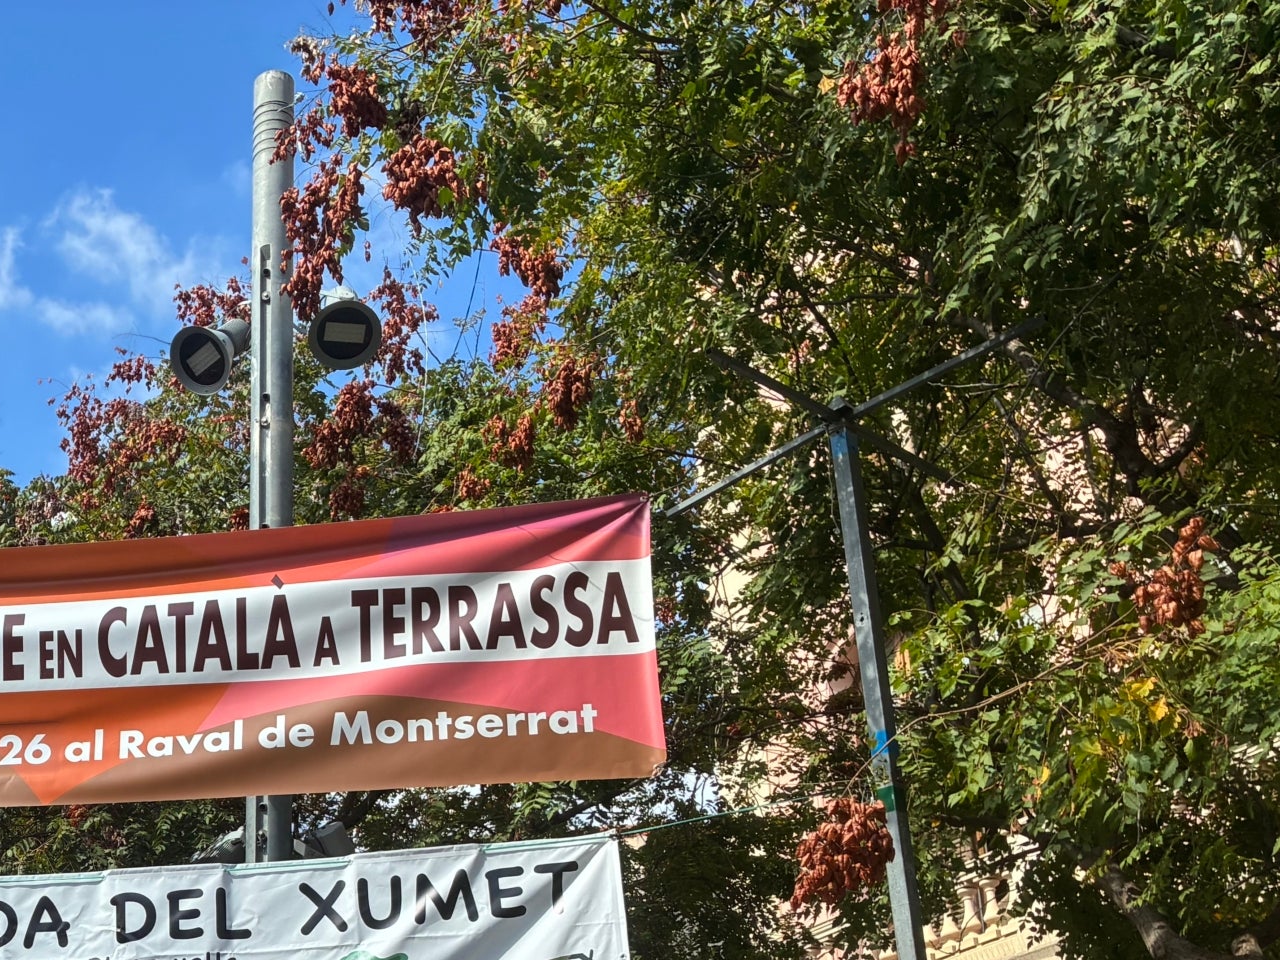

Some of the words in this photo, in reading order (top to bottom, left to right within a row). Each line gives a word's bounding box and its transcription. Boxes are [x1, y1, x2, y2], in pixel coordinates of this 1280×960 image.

[39, 629, 83, 679] EN
[98, 574, 301, 678] CATALÀ
[313, 616, 340, 667] A
[351, 571, 639, 663] TERRASSA
[64, 729, 104, 763] al
[119, 719, 243, 759] Raval
[258, 715, 314, 748] de
[330, 703, 598, 746] Montserrat
[110, 887, 252, 944] DEL
[299, 861, 578, 935] XUMET
